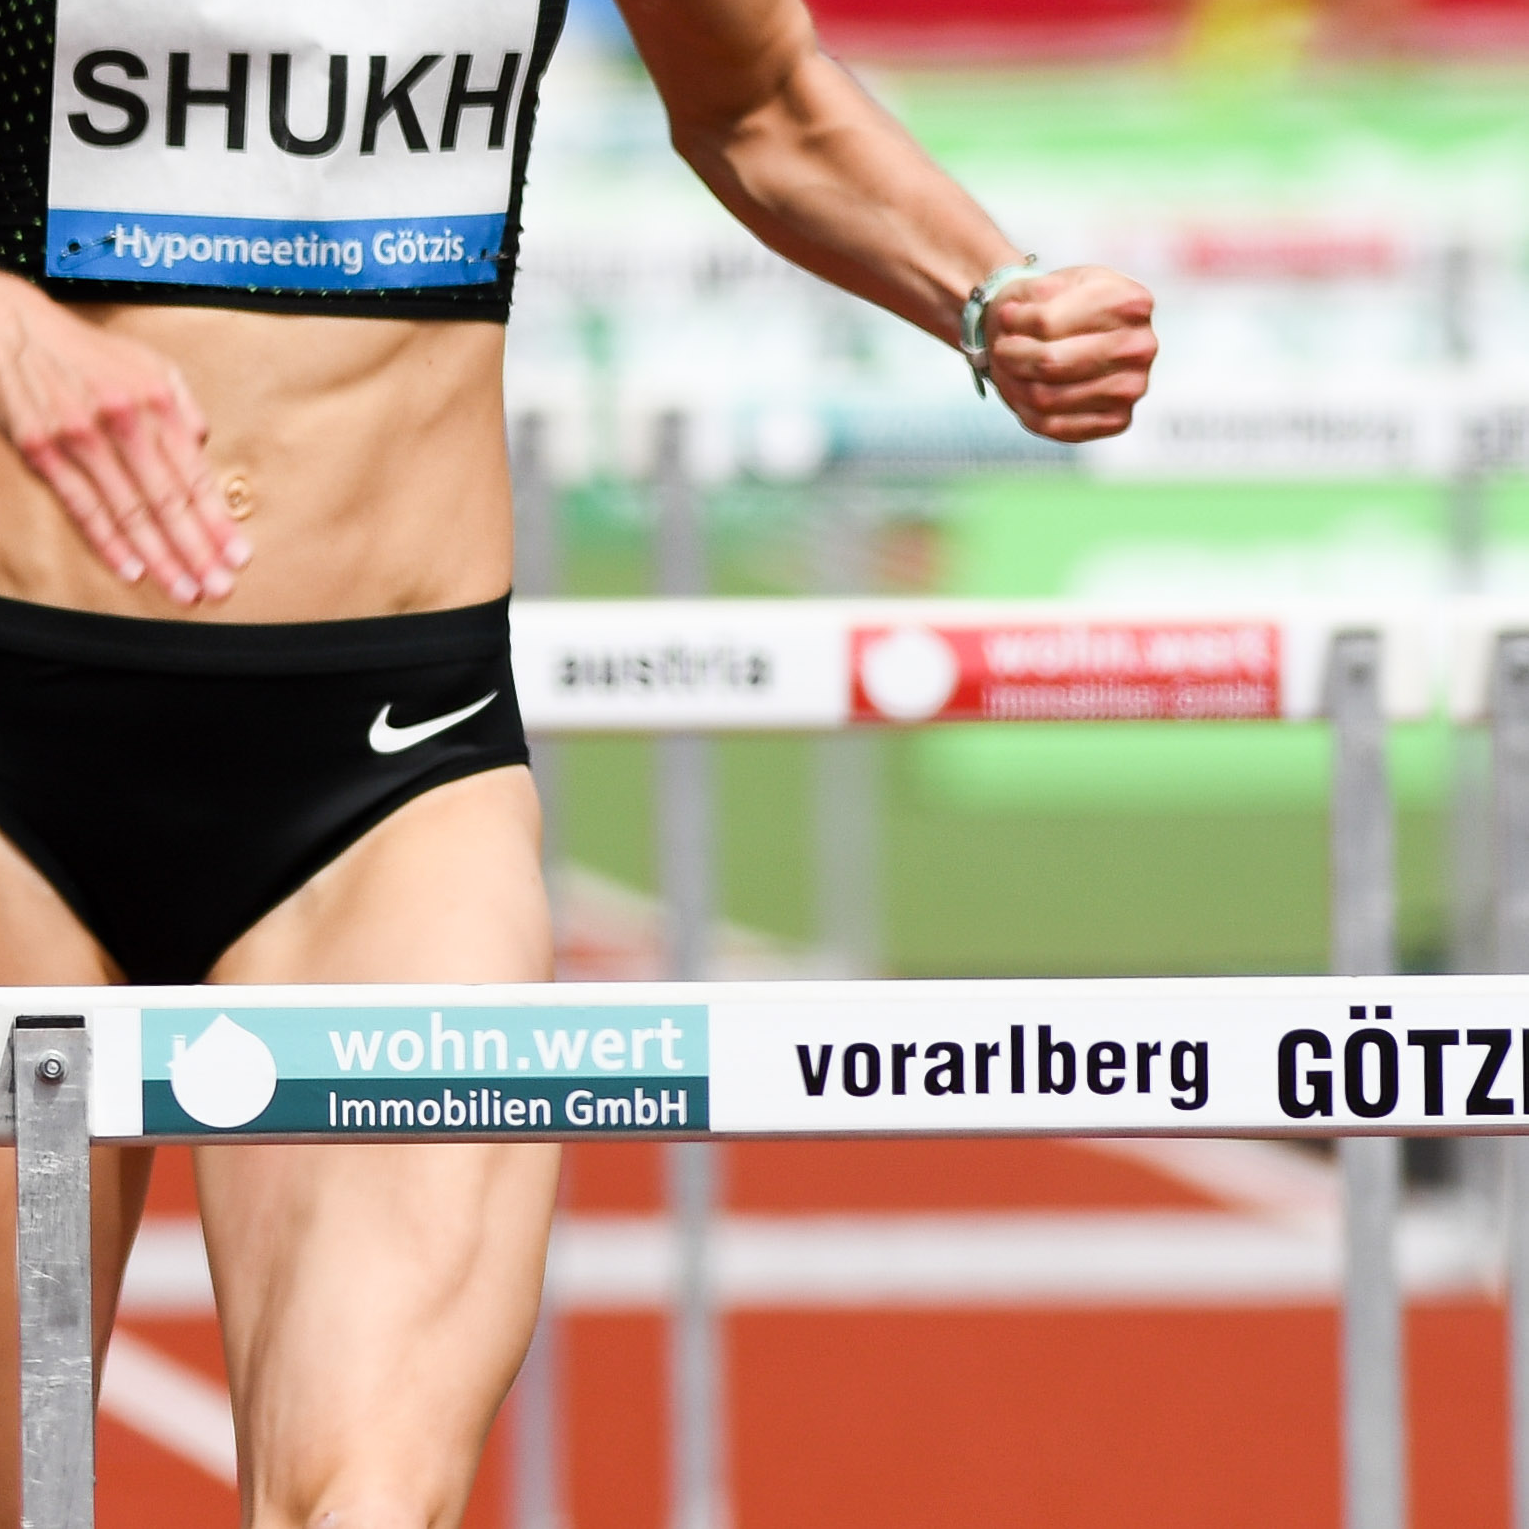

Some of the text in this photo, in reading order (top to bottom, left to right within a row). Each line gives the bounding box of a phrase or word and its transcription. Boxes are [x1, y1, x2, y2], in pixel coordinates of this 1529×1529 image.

[67, 50, 522, 157] SHUKH
[115, 225, 465, 274] Hypomeeting Götzis
[329, 1012, 684, 1072] wohn.wert
[796, 1025, 1209, 1110] vorarlberg
[329, 1087, 688, 1129] Immobilien GmbH
